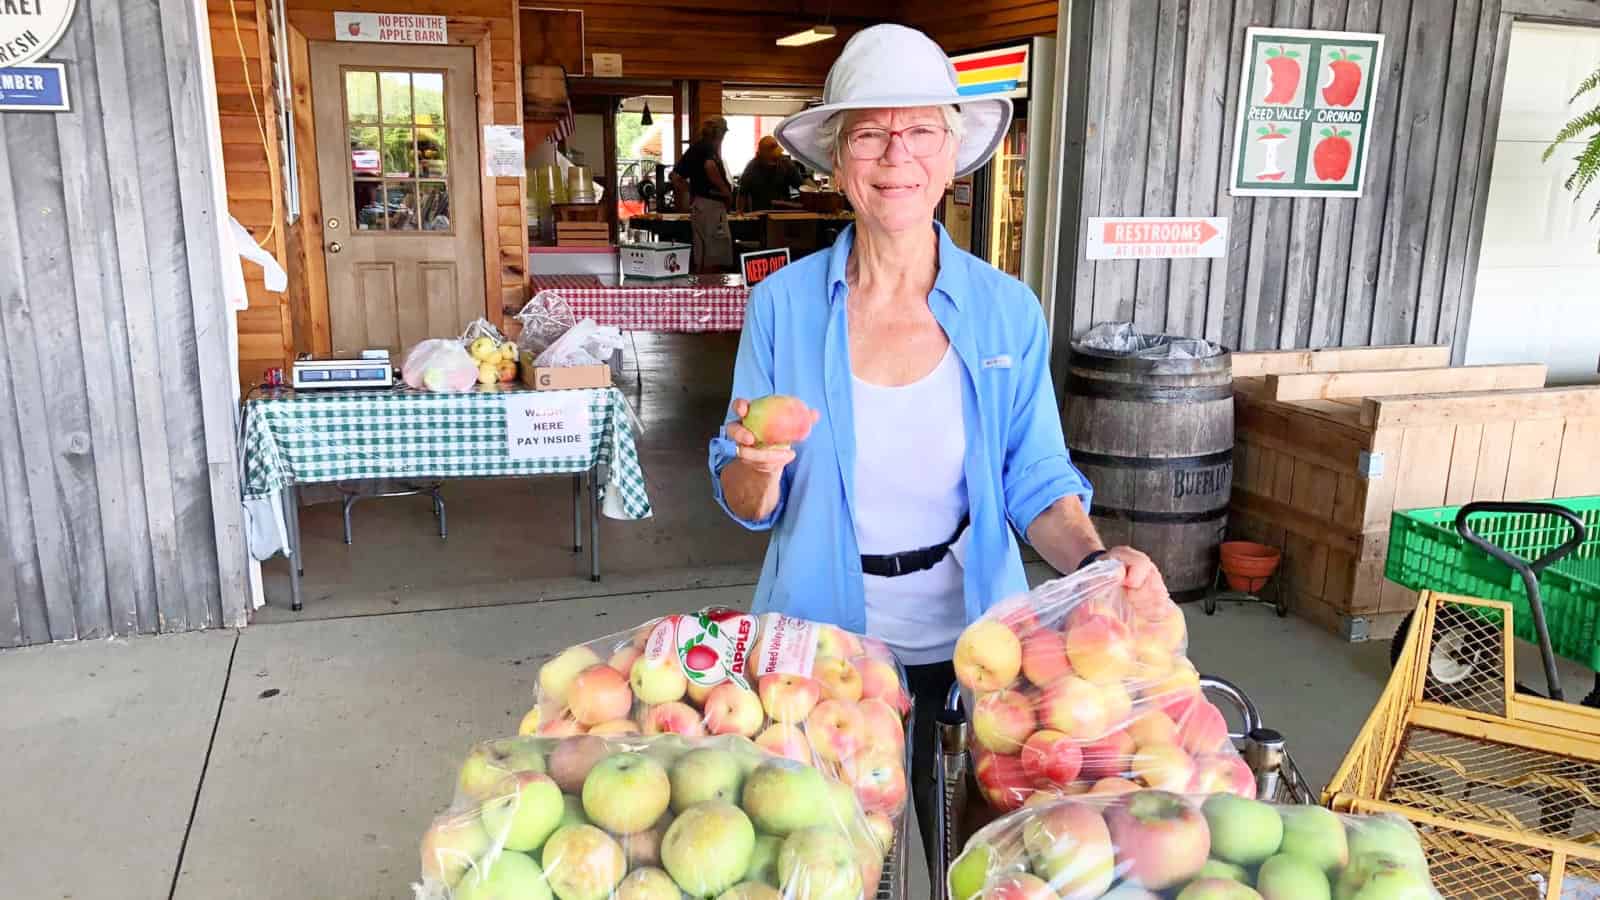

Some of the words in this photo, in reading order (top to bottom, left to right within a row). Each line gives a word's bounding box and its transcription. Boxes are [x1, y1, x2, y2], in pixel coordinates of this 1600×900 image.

[378, 15, 391, 27] NO
[393, 15, 413, 28] PETS
[415, 17, 425, 29] IN
[427, 17, 444, 29] THE
[379, 28, 412, 41] APPLE
[414, 29, 444, 41] BARN
[0, 74, 45, 90] MBER
[1247, 106, 1274, 121] REED
[1276, 107, 1312, 121] VALLEY
[1317, 109, 1362, 122] ORCHARD
[1115, 222, 1201, 241] RESTROOMS
[746, 258, 768, 282] KEEP
[534, 421, 565, 431] HERE
[517, 437, 539, 446] PAY
[543, 434, 581, 445] INSIDE
[732, 619, 752, 673] APPLES
[765, 650, 779, 673] Reed
